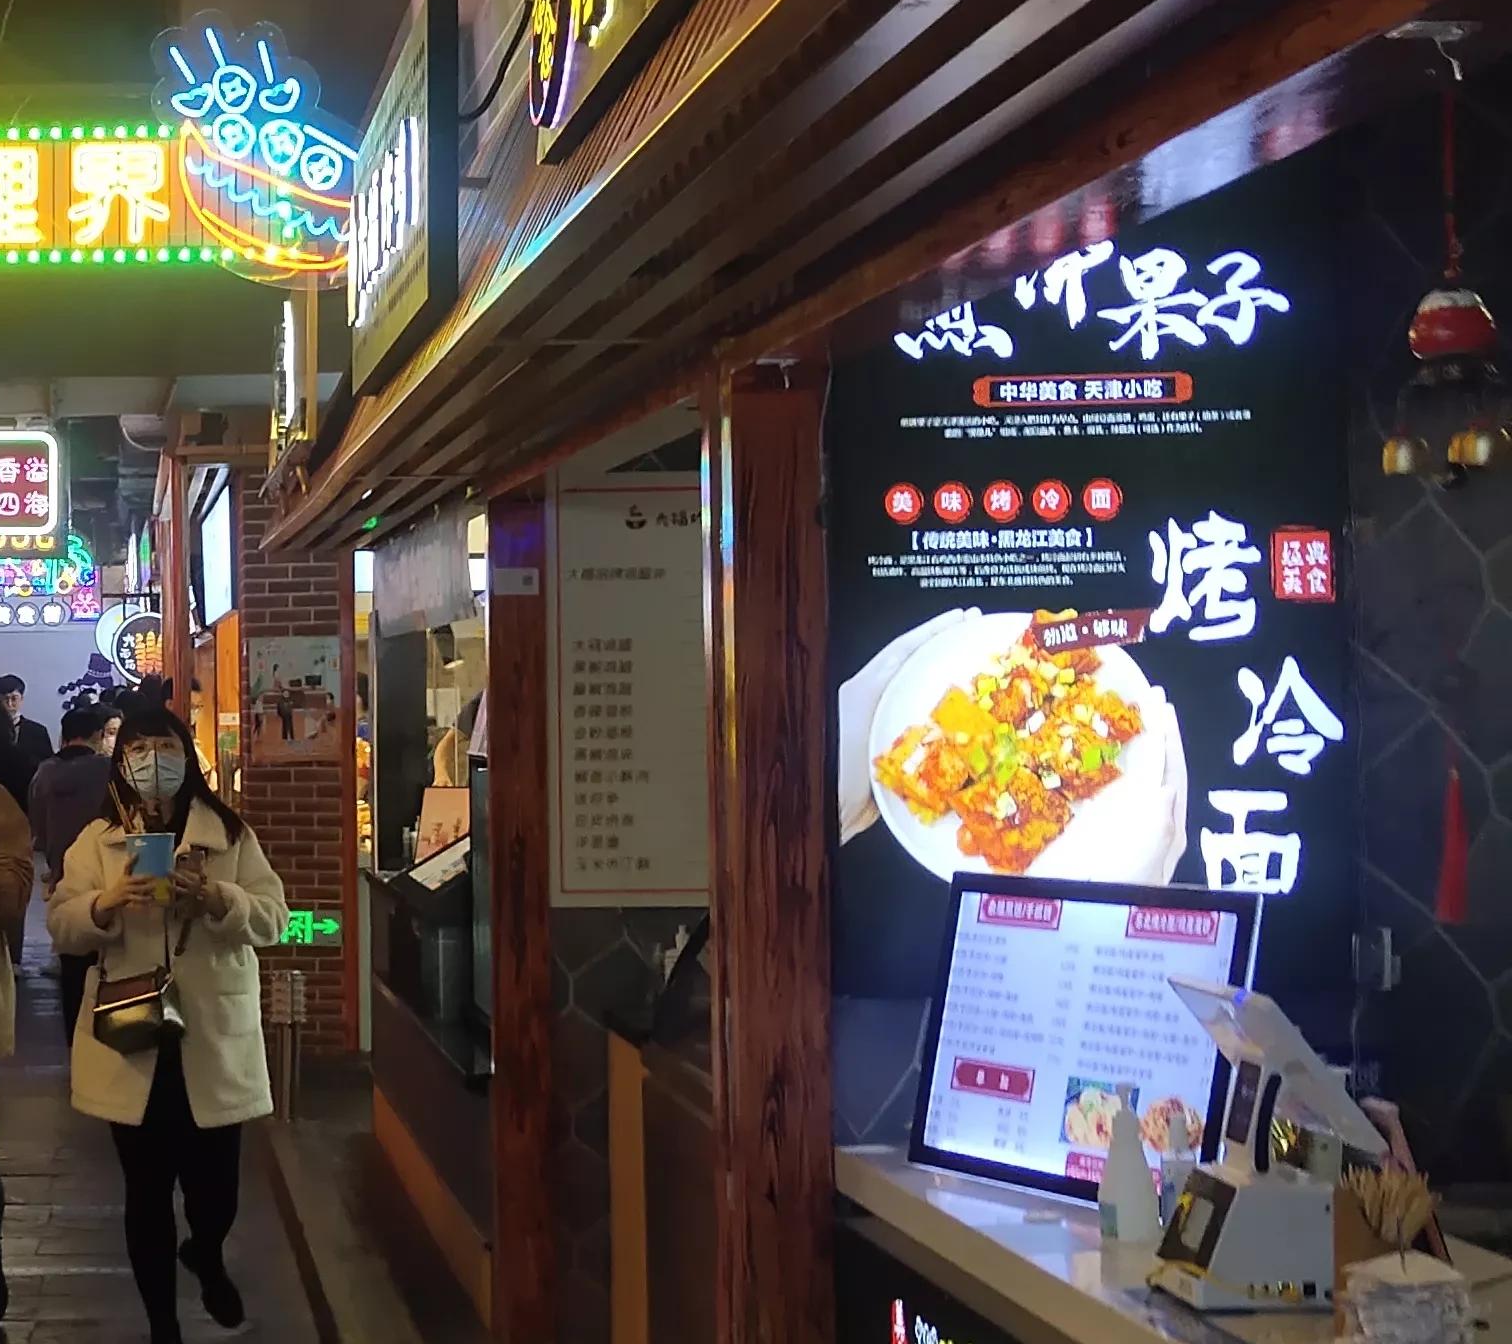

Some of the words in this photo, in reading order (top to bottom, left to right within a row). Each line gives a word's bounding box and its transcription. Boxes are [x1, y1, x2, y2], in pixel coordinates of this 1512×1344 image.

[999, 378, 1078, 403] 中华美食
[1084, 378, 1165, 401] 天津小吃
[891, 485, 1115, 513] 美味烤冷面
[1281, 567, 1329, 594] 美食
[1148, 510, 1346, 894] 烤冷面
